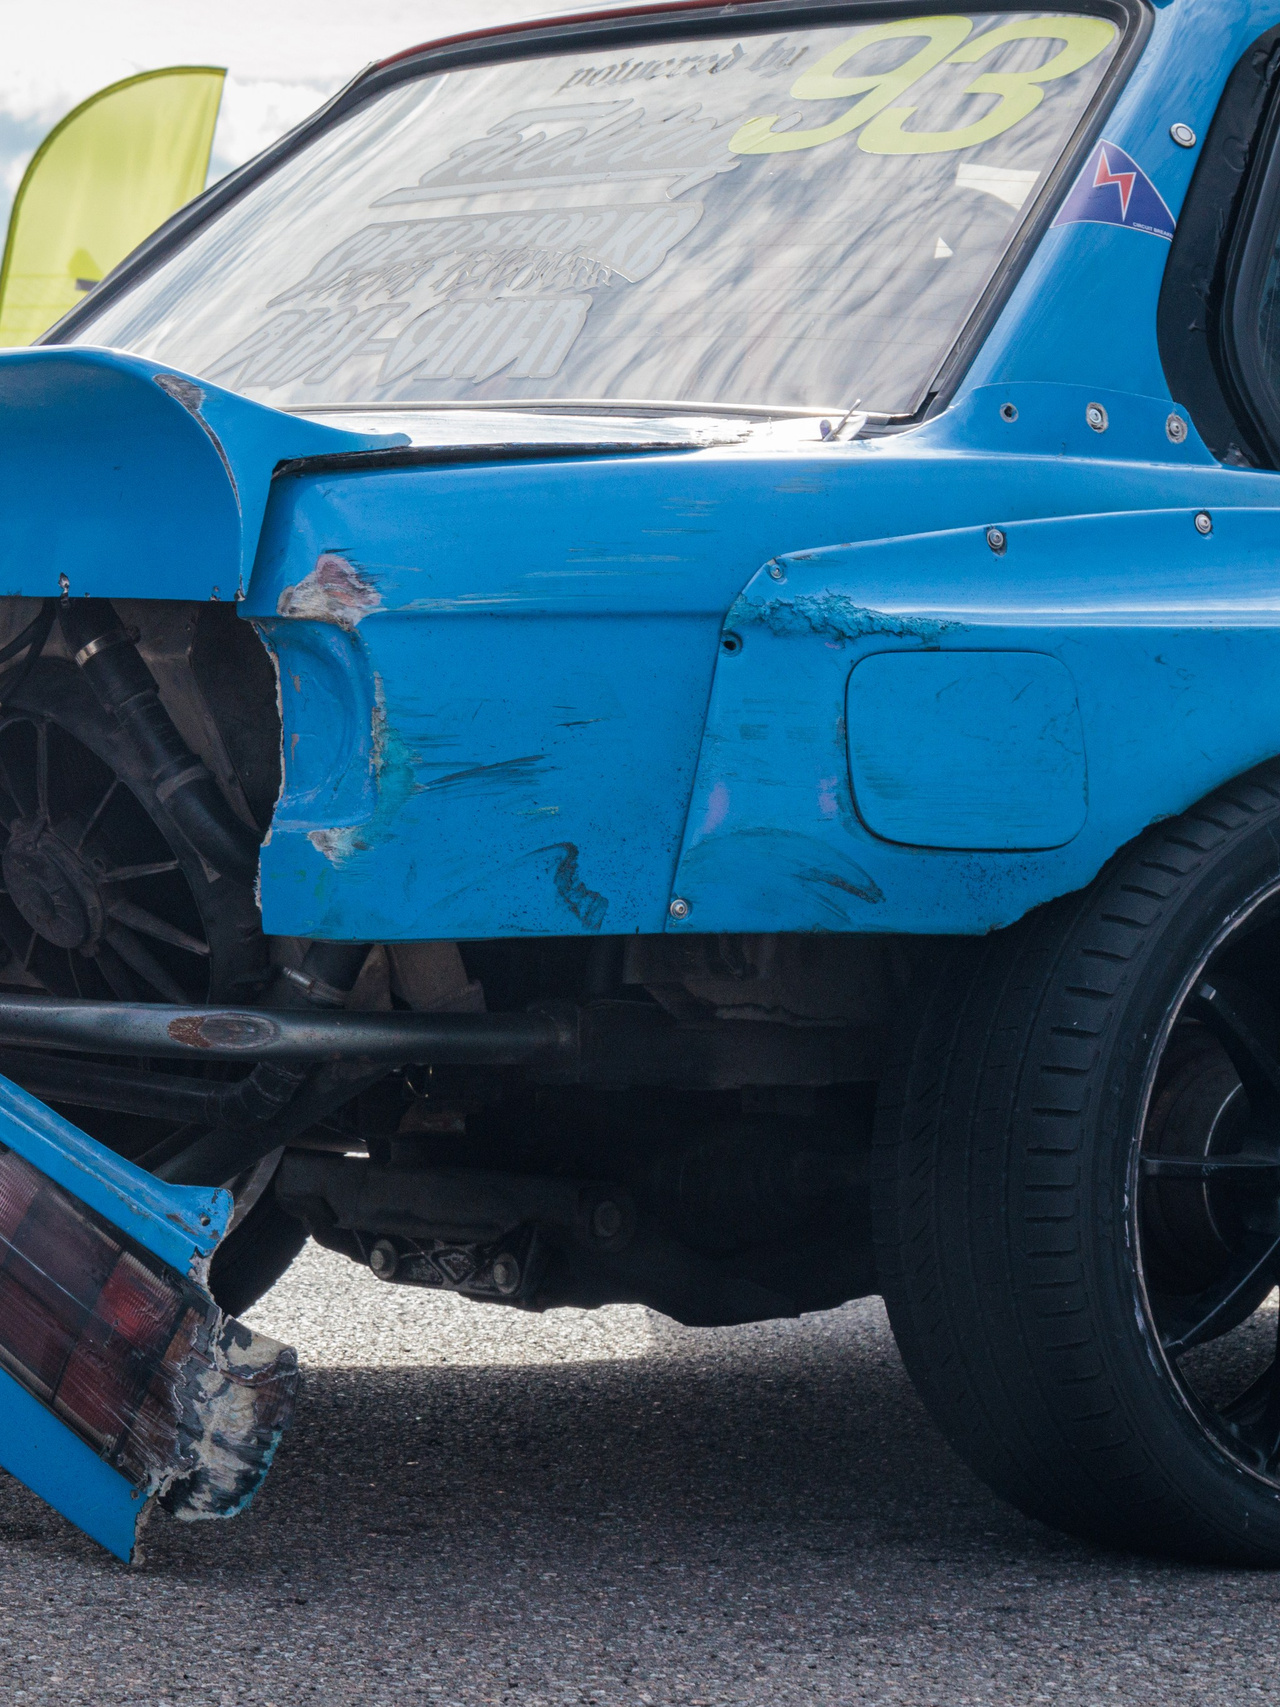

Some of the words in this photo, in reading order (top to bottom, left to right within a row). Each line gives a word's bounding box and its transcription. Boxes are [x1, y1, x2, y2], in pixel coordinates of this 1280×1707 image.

[552, 43, 746, 97] powered
[746, 37, 810, 79] by
[728, 15, 1116, 154] 93
[274, 211, 604, 303] SPEEDSHOP
[598, 205, 696, 279] KB
[202, 296, 590, 389] BLAST-CENTER
